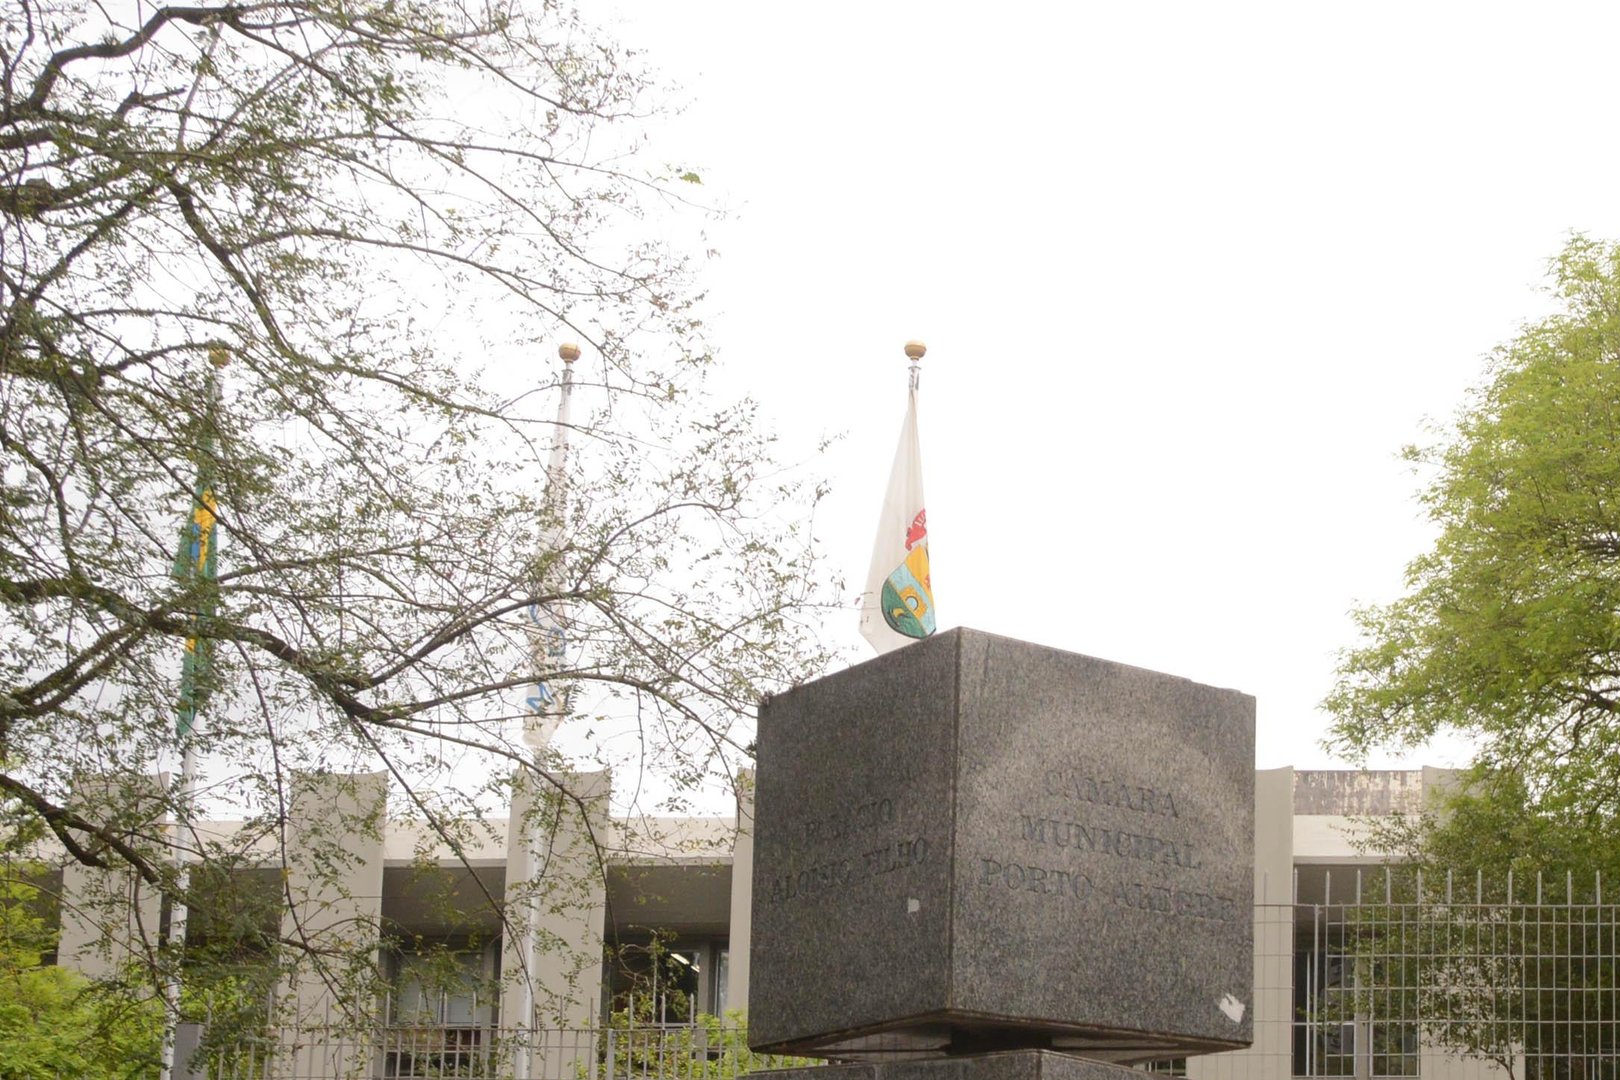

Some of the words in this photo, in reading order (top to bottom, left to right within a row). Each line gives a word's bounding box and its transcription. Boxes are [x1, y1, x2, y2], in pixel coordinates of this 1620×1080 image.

[1019, 814, 1203, 870] MUNICIPAL
[977, 857, 1097, 901] PORTO
[1112, 880, 1236, 922] ALEGRE
